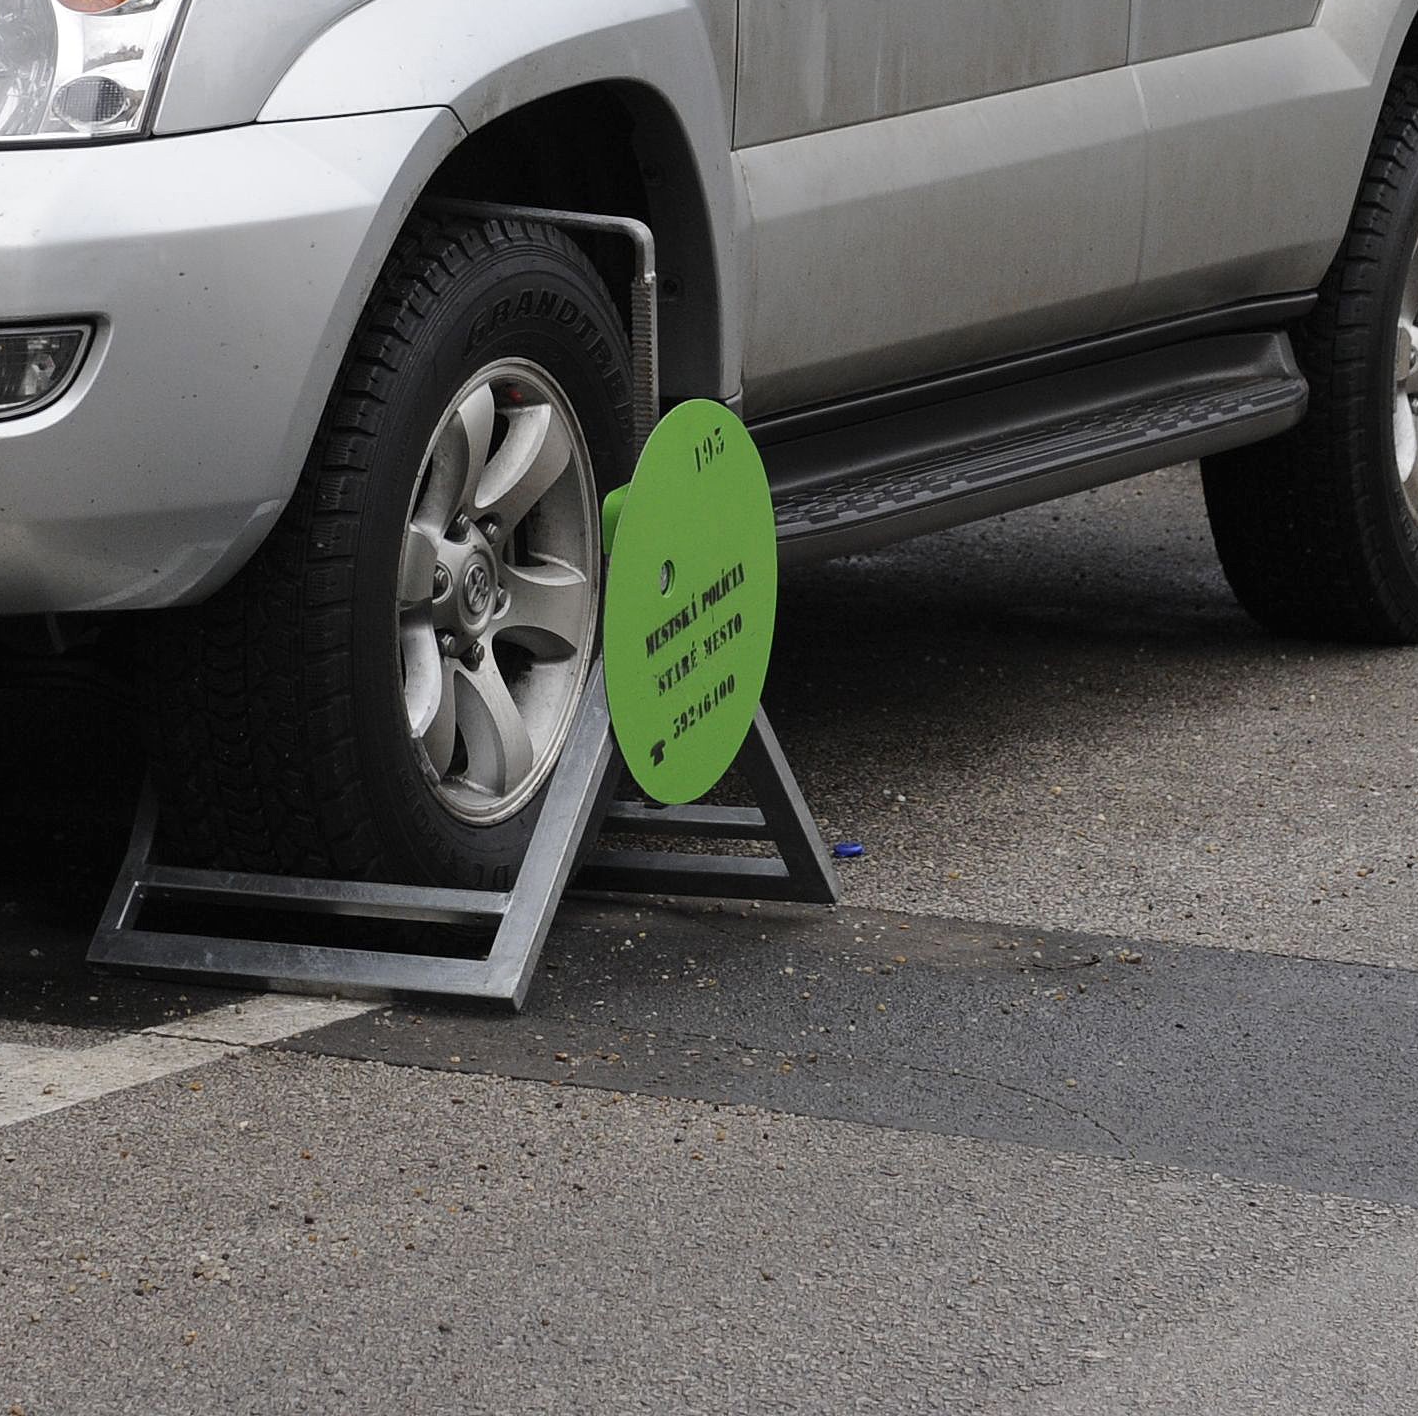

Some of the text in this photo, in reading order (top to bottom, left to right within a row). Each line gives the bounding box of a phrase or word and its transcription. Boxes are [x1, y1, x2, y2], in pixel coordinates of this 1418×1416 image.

[694, 426, 725, 473] 195
[645, 562, 745, 659] MESTSKÁ POLÍCIA
[658, 612, 743, 697] STARÉ MESTO
